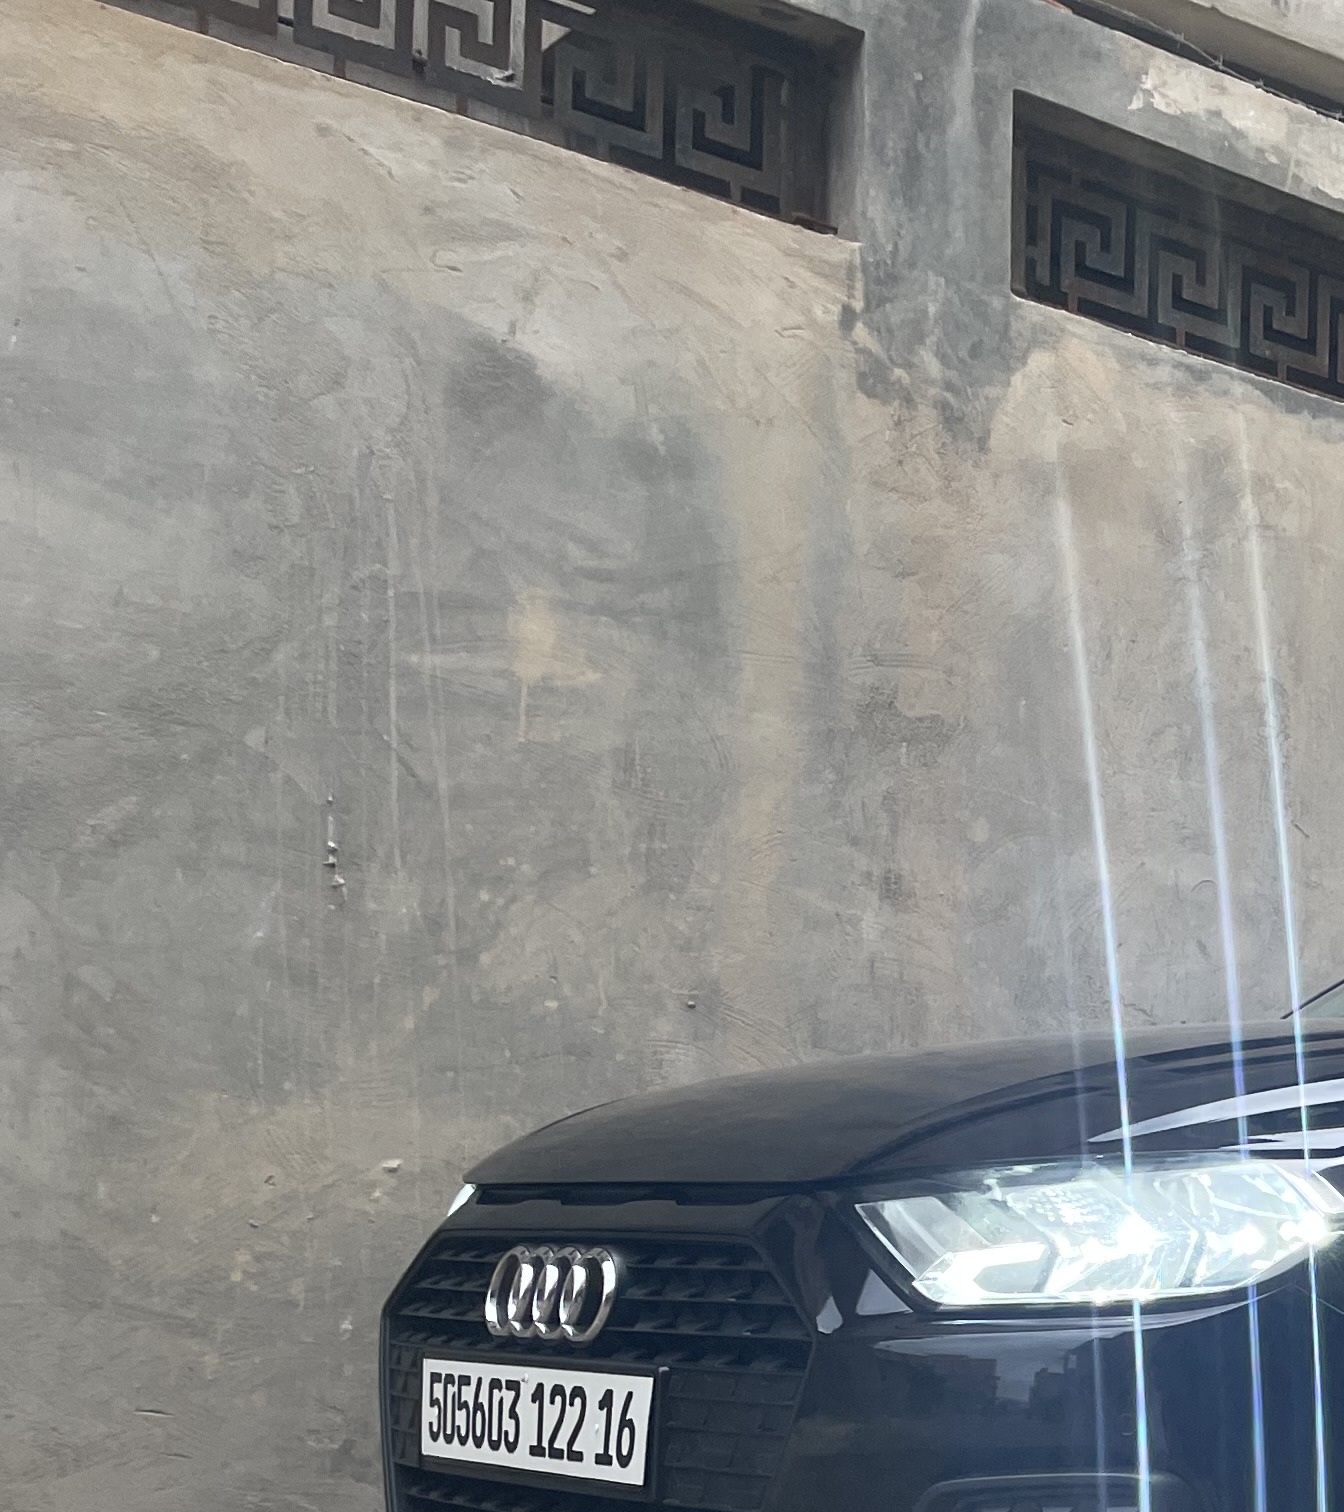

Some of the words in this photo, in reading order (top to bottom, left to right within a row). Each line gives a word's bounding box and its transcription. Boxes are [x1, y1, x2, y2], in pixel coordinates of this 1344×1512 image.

[428, 1371, 521, 1454] 505603
[529, 1382, 587, 1463] 122
[594, 1388, 636, 1469] 16
